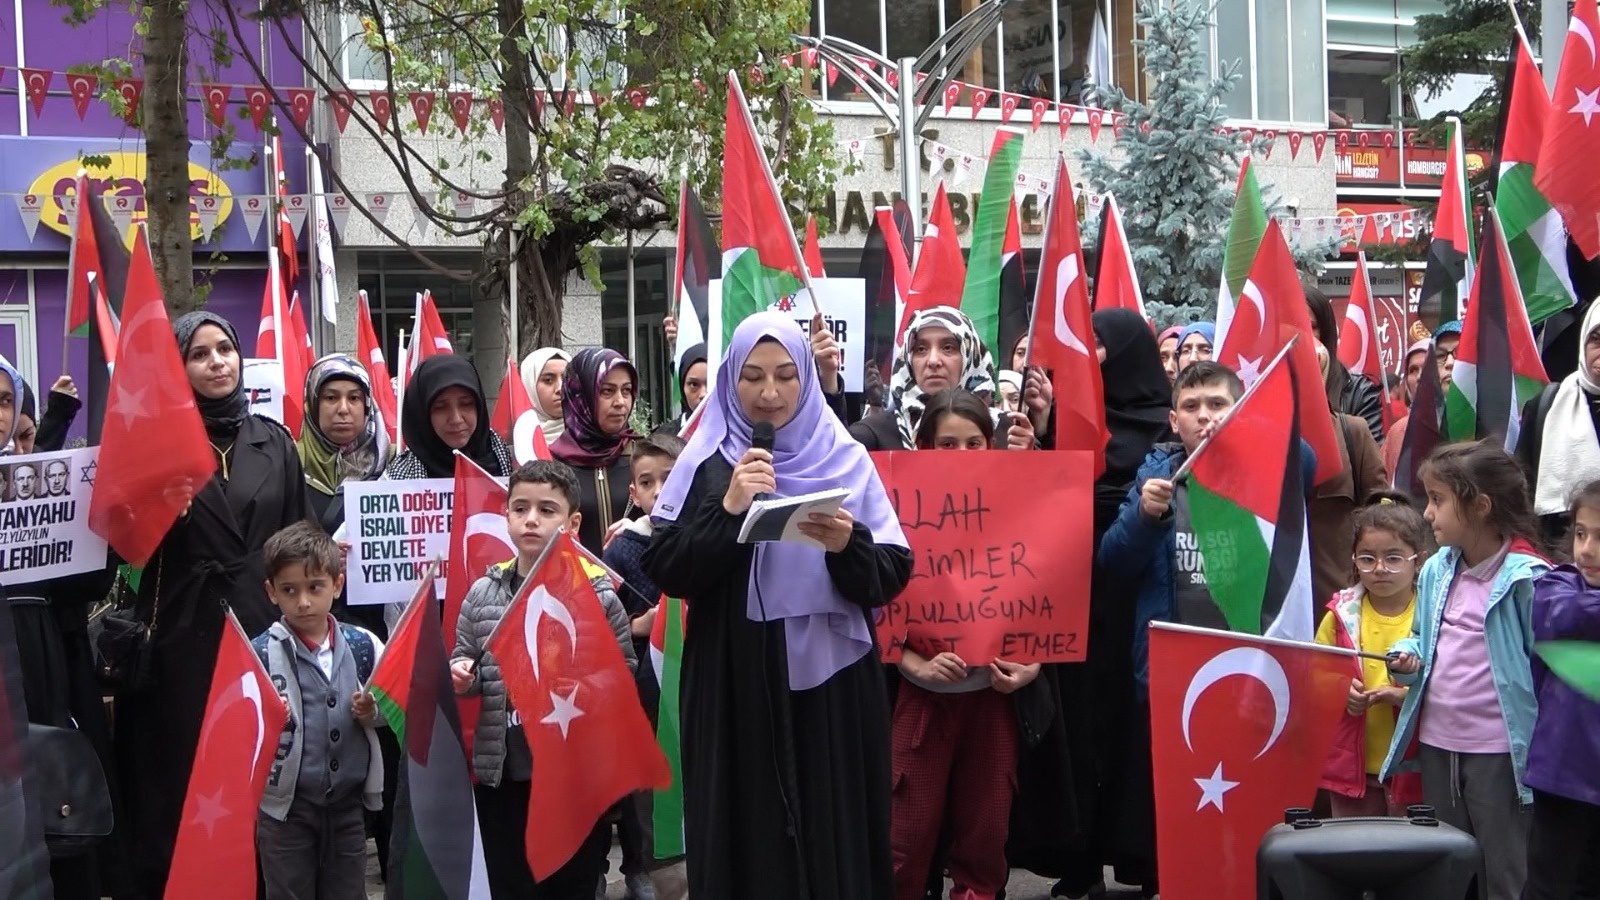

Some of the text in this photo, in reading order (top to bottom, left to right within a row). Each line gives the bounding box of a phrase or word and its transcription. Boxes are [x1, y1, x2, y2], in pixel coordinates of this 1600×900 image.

[360, 494, 399, 514] ORTA
[411, 512, 444, 534] DİYE
[361, 538, 426, 560] DEVLETE
[361, 564, 391, 583] YER
[1000, 632, 1079, 657] ETMEZ
